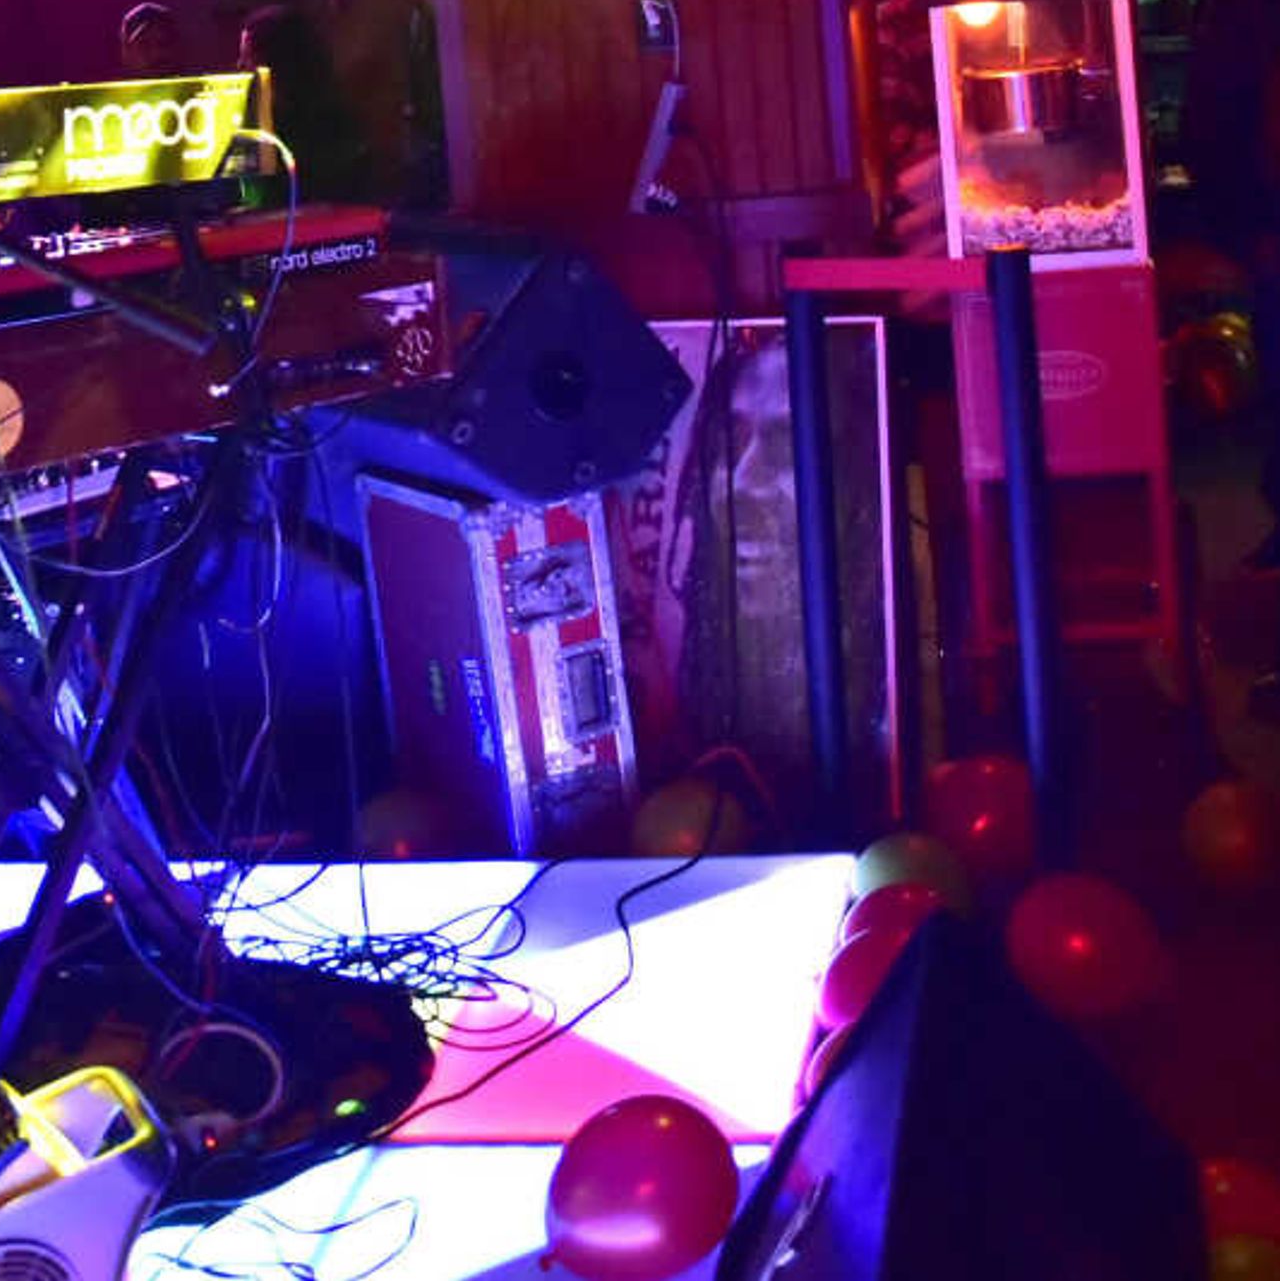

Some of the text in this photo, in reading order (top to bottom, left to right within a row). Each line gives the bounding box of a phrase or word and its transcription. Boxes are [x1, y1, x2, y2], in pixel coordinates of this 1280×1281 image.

[64, 98, 218, 160] moog
[269, 236, 378, 272] nord electro 2
